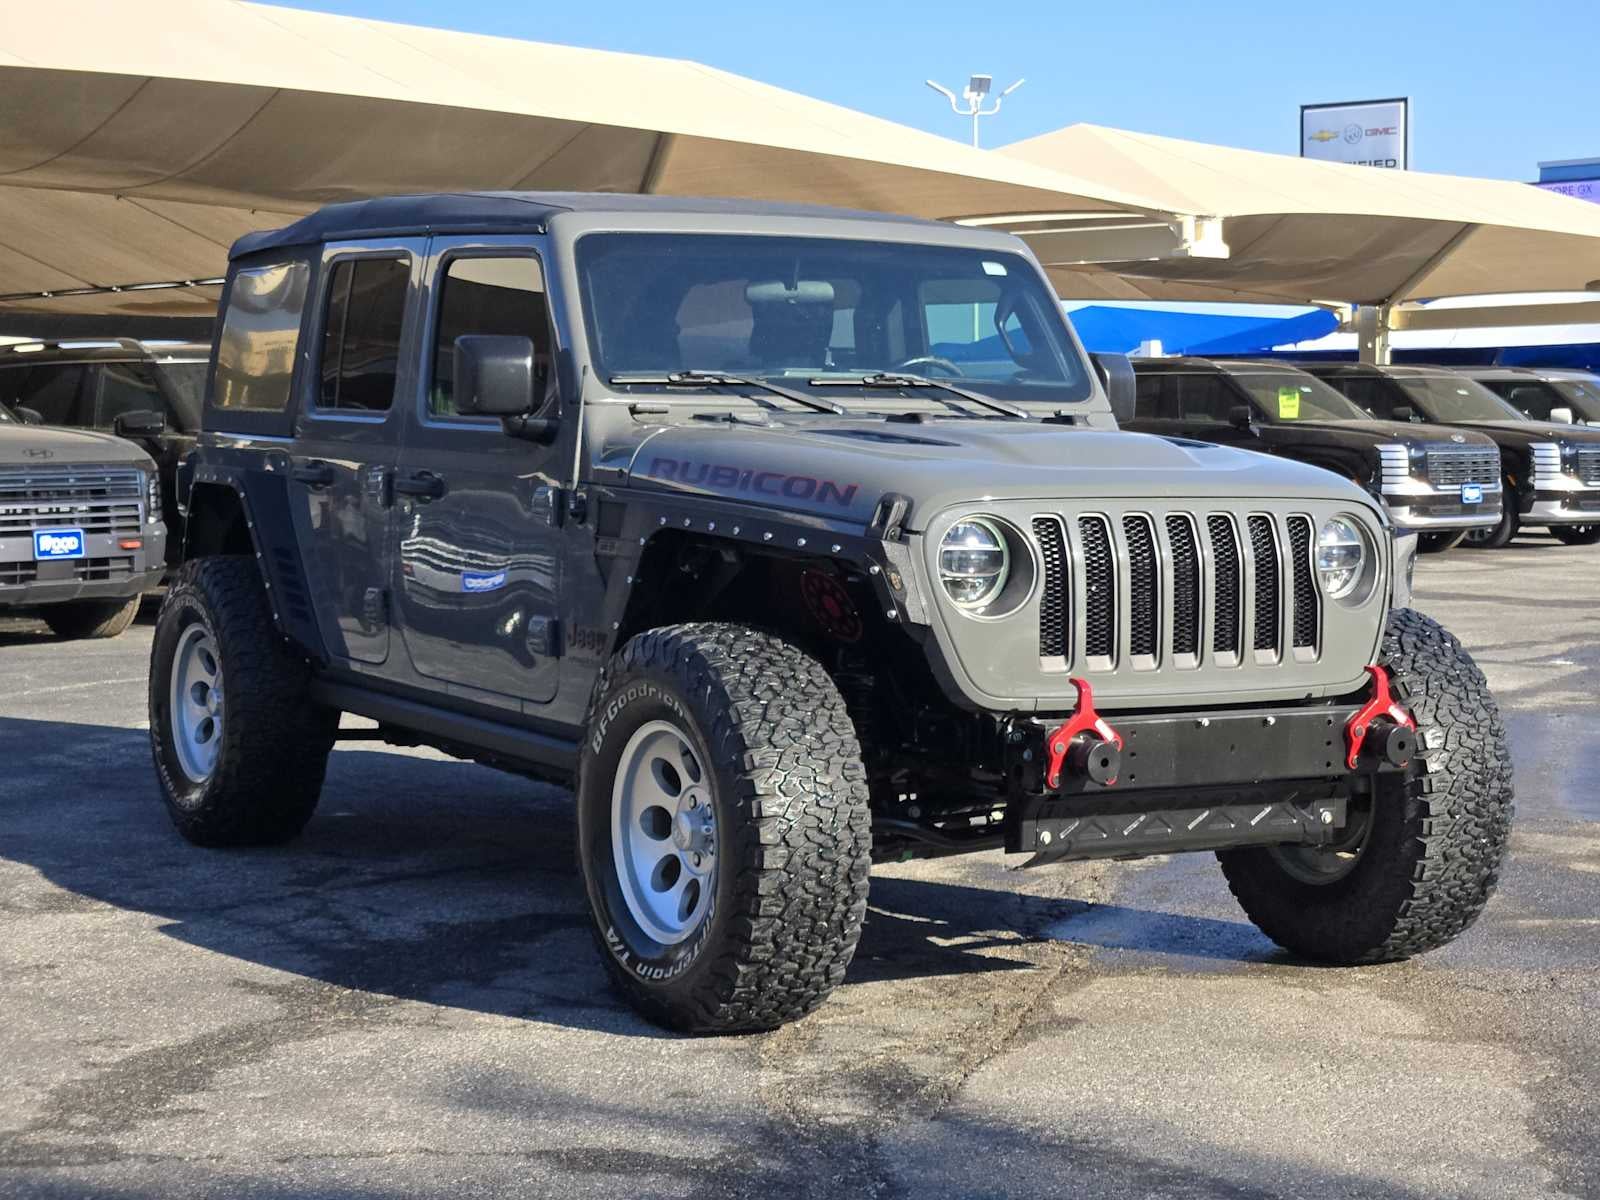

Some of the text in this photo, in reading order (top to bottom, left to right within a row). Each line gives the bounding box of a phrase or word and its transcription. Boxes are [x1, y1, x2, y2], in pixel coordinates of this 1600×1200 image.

[1365, 127, 1397, 137] GMC
[648, 458, 859, 506] RUBICON
[568, 623, 609, 657] Jeep
[592, 683, 684, 755] BFGoodrich
